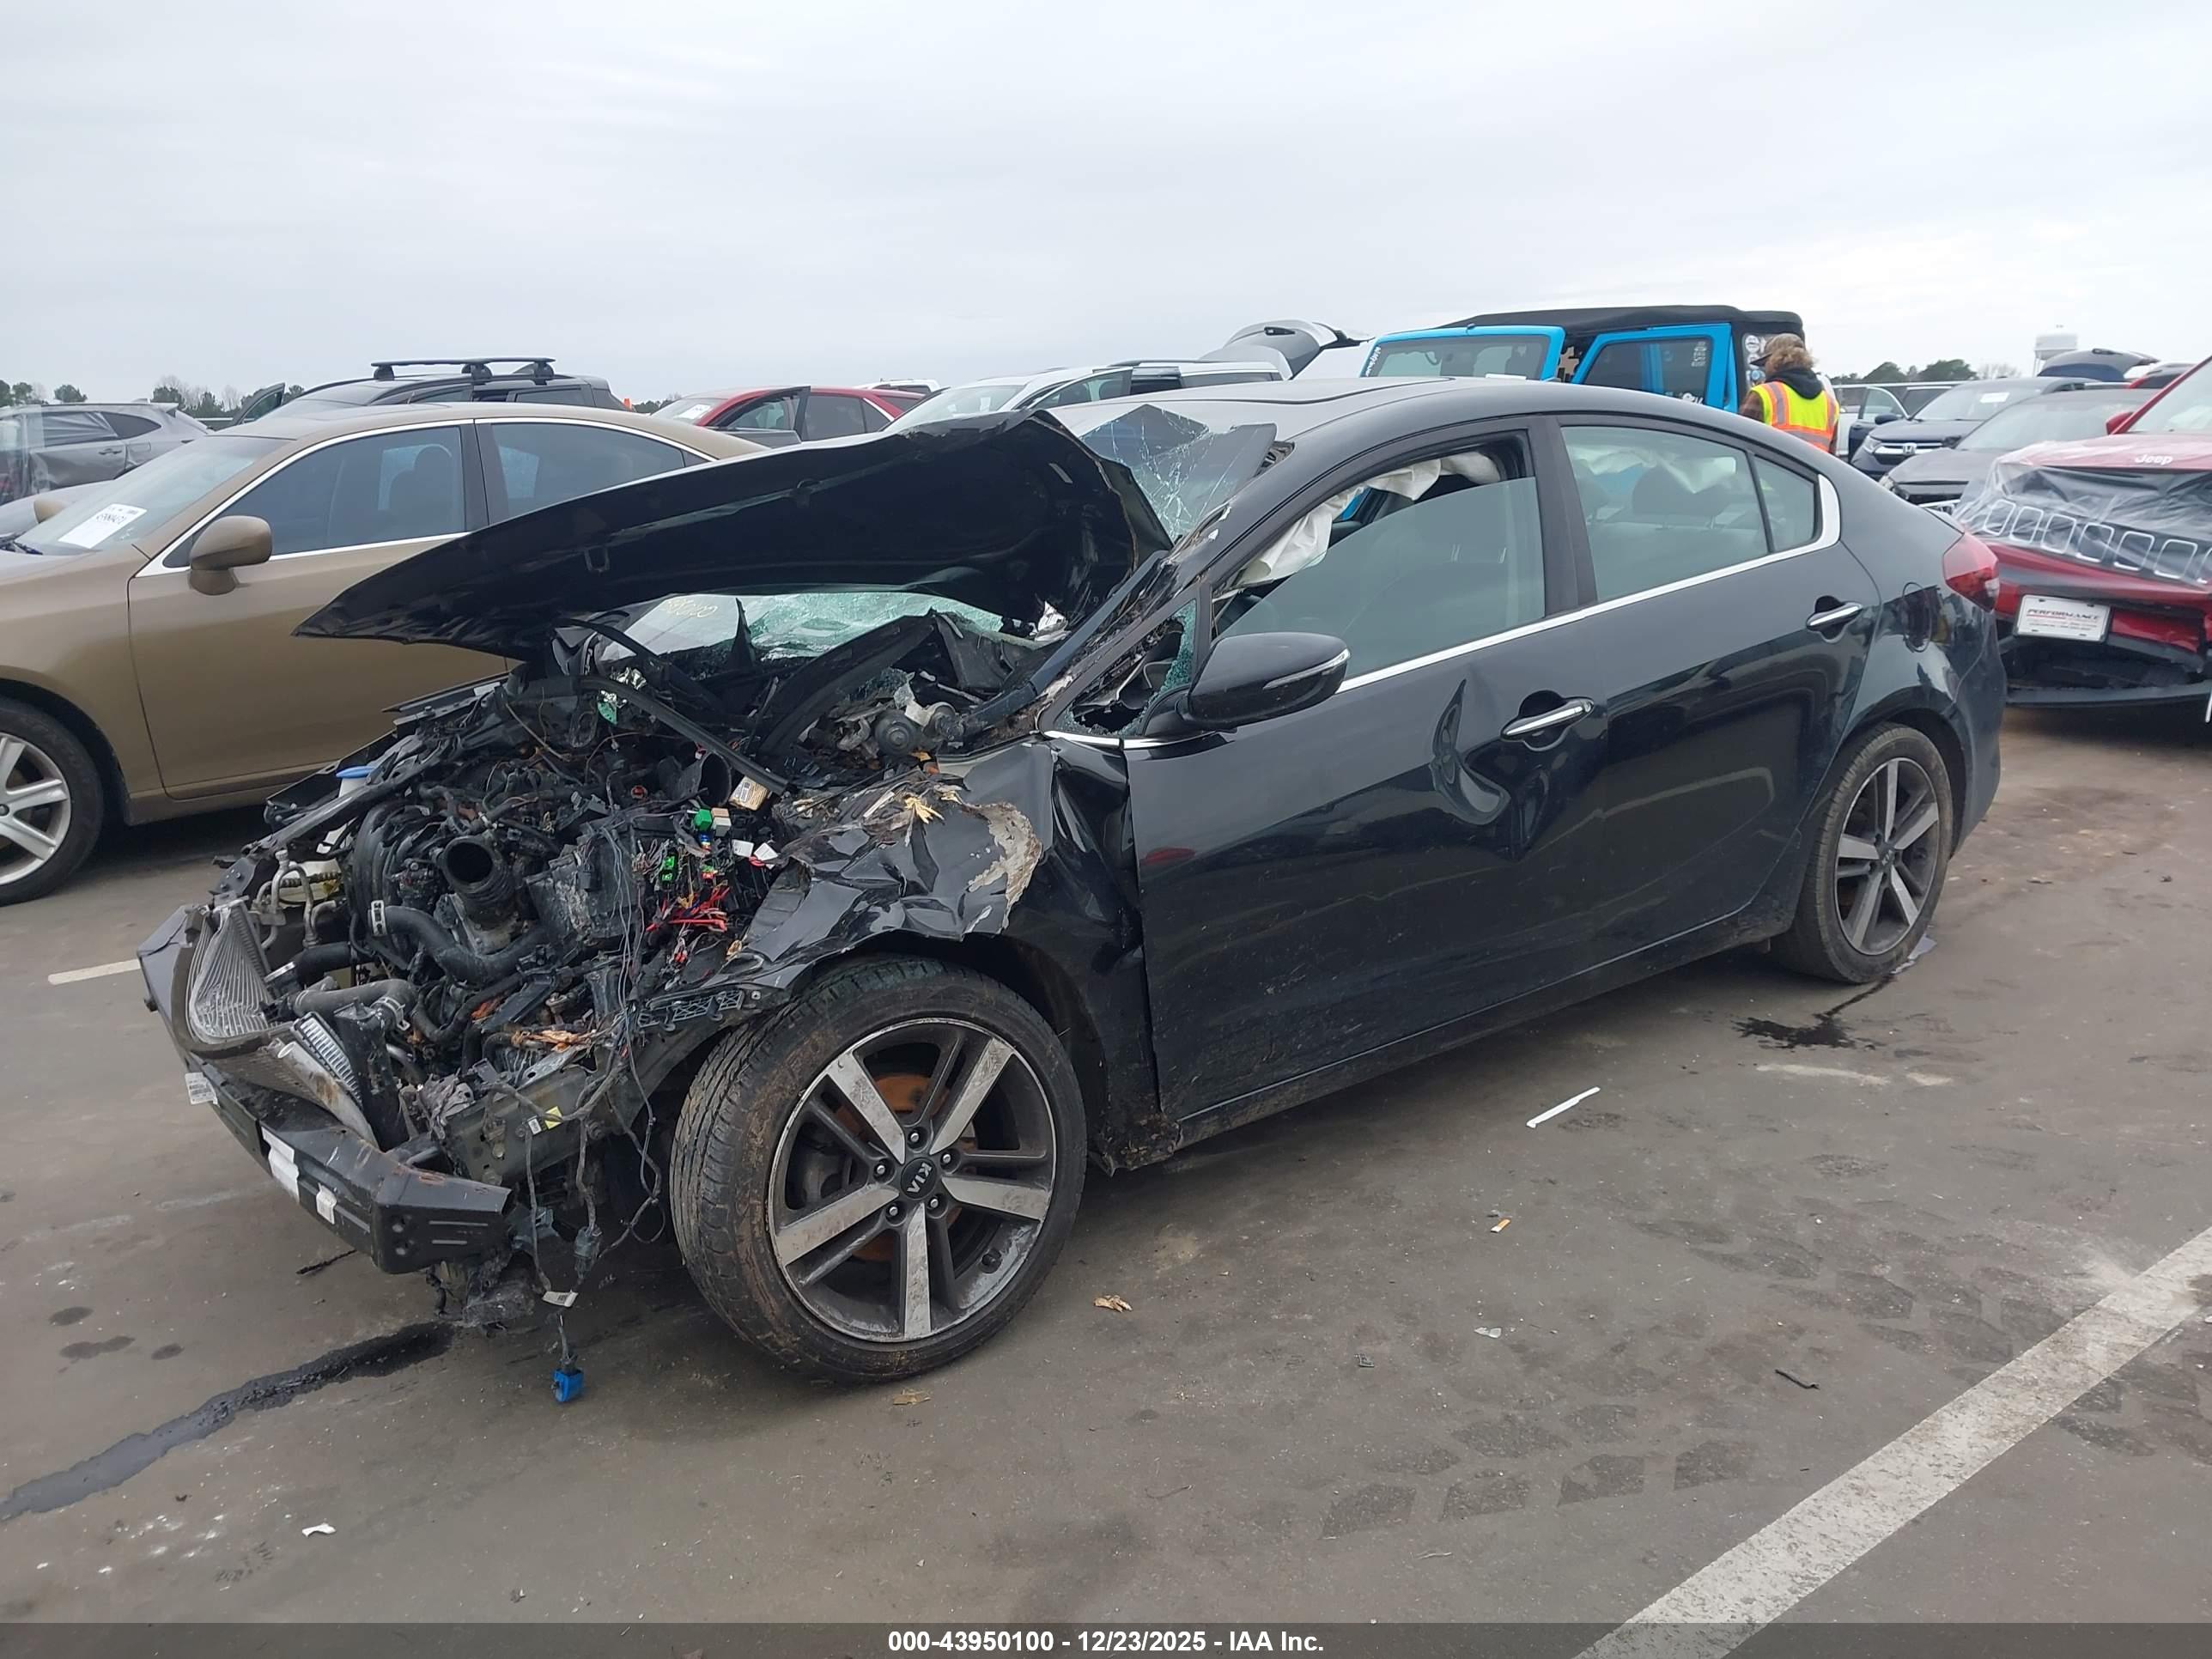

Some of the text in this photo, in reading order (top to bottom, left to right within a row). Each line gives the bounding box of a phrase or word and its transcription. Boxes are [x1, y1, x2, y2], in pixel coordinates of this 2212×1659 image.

[2135, 453, 2173, 465] Jeep
[2027, 608, 2100, 620] PERFORMANCE
[907, 1162, 933, 1194] KIA
